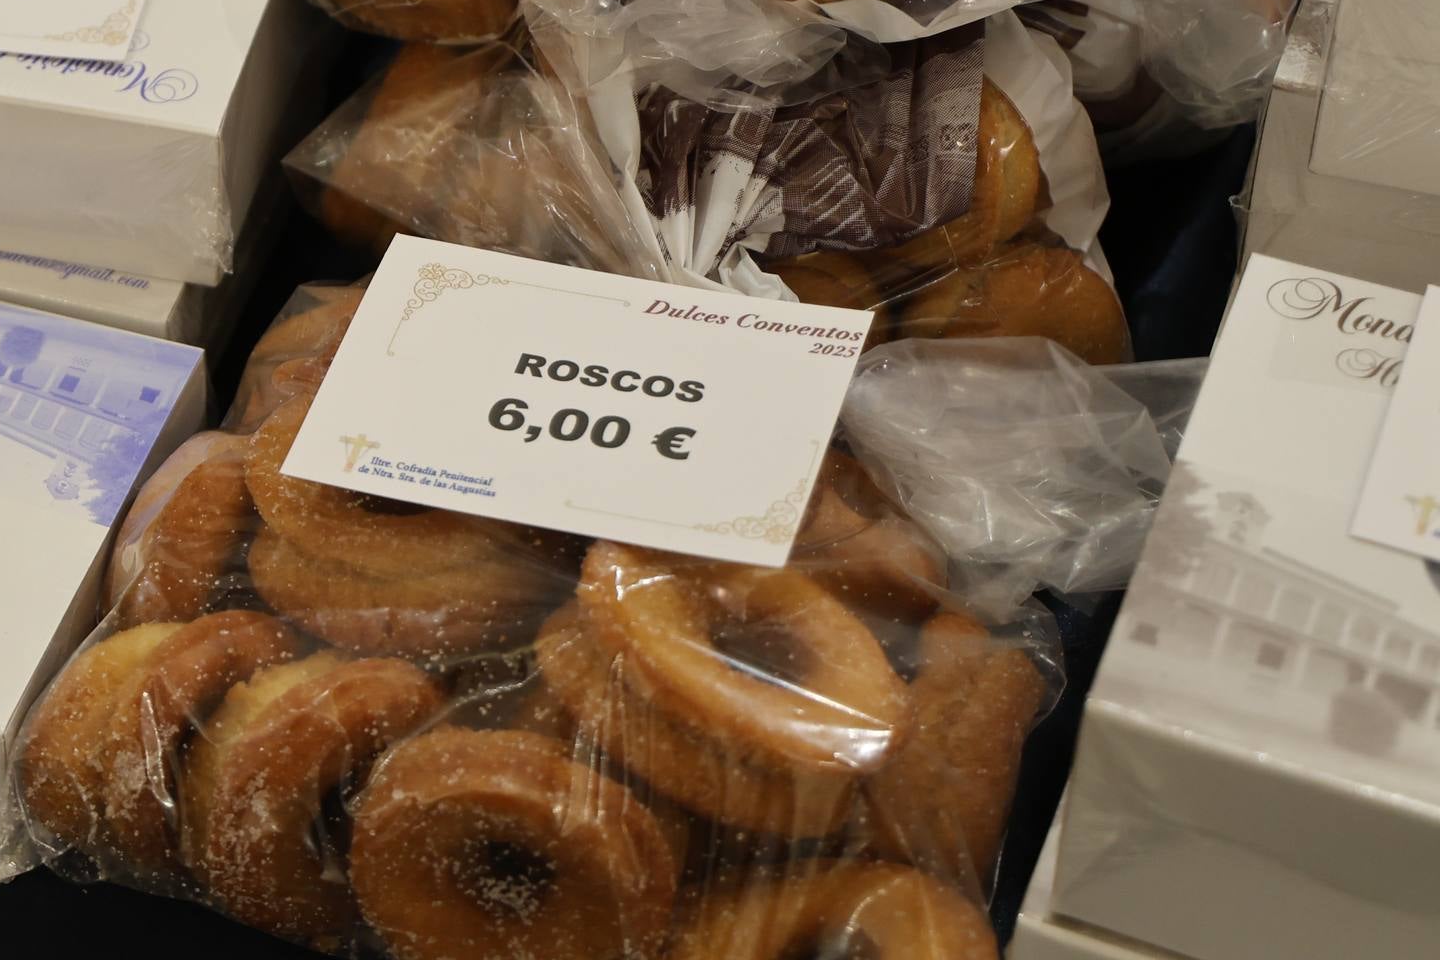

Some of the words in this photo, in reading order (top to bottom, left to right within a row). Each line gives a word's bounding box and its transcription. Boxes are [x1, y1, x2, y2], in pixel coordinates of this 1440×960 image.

[642, 299, 729, 326] Dulces
[736, 313, 864, 342] Conventos
[809, 342, 858, 359] 2025
[514, 352, 705, 403] ROSCOS
[487, 397, 631, 449] 6,00
[652, 426, 698, 461] €
[358, 465, 370, 473] de
[371, 468, 394, 479] Ntra.
[398, 472, 416, 482] Sra.
[419, 476, 431, 485] de
[433, 479, 447, 488] las
[440, 469, 494, 487] Penitencial
